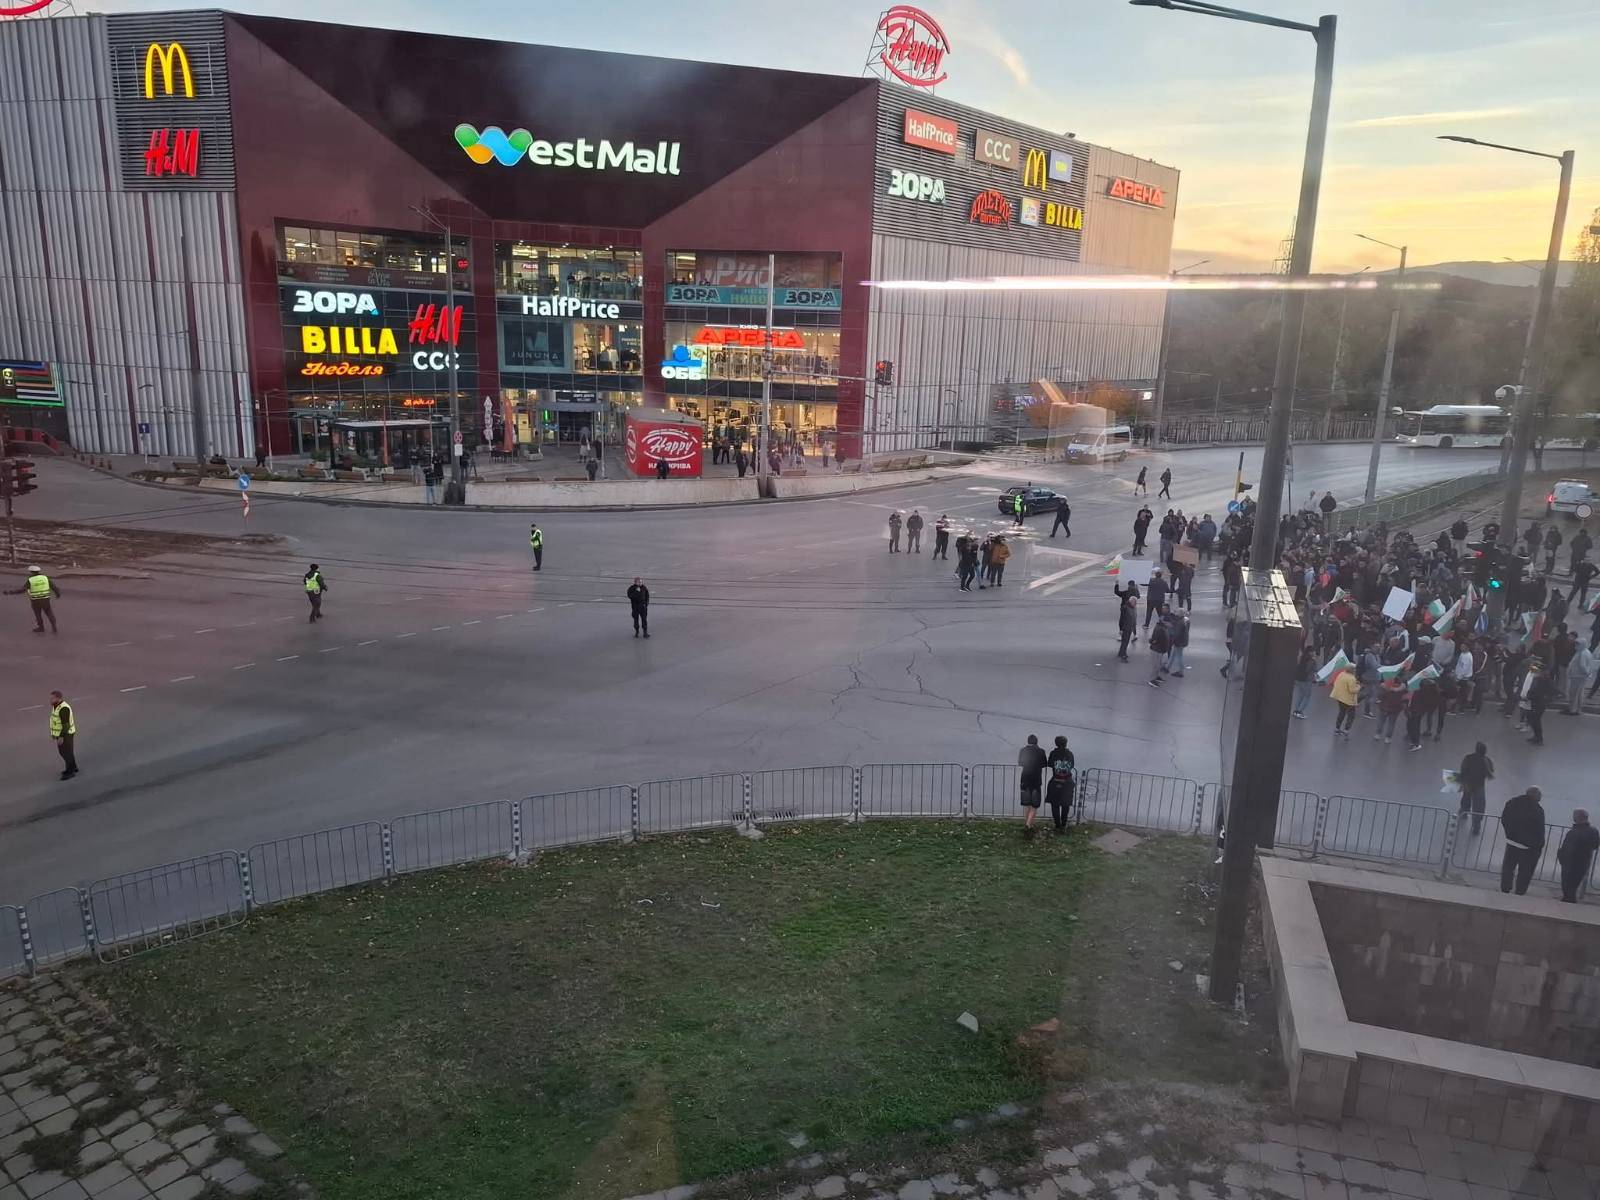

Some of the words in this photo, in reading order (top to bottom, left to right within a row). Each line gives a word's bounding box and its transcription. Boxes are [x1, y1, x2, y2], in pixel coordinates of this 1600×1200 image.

[887, 22, 944, 74] Happy
[908, 118, 953, 146] HalfPrice
[144, 128, 200, 177] H&M
[984, 137, 1012, 162] CCC
[888, 169, 945, 204] ЗОРА
[1109, 178, 1164, 207] АРЕНА
[1045, 202, 1082, 230] BILLA
[293, 290, 379, 315] ЗОРА
[521, 295, 620, 319] HalfPrice
[671, 287, 720, 303] ЗОРА
[784, 290, 838, 306] ЗОРА
[408, 303, 464, 347] H&M
[301, 325, 399, 355] BILLA
[300, 361, 385, 377] Неделя
[412, 351, 460, 371] CCC
[647, 436, 693, 455] Happy
